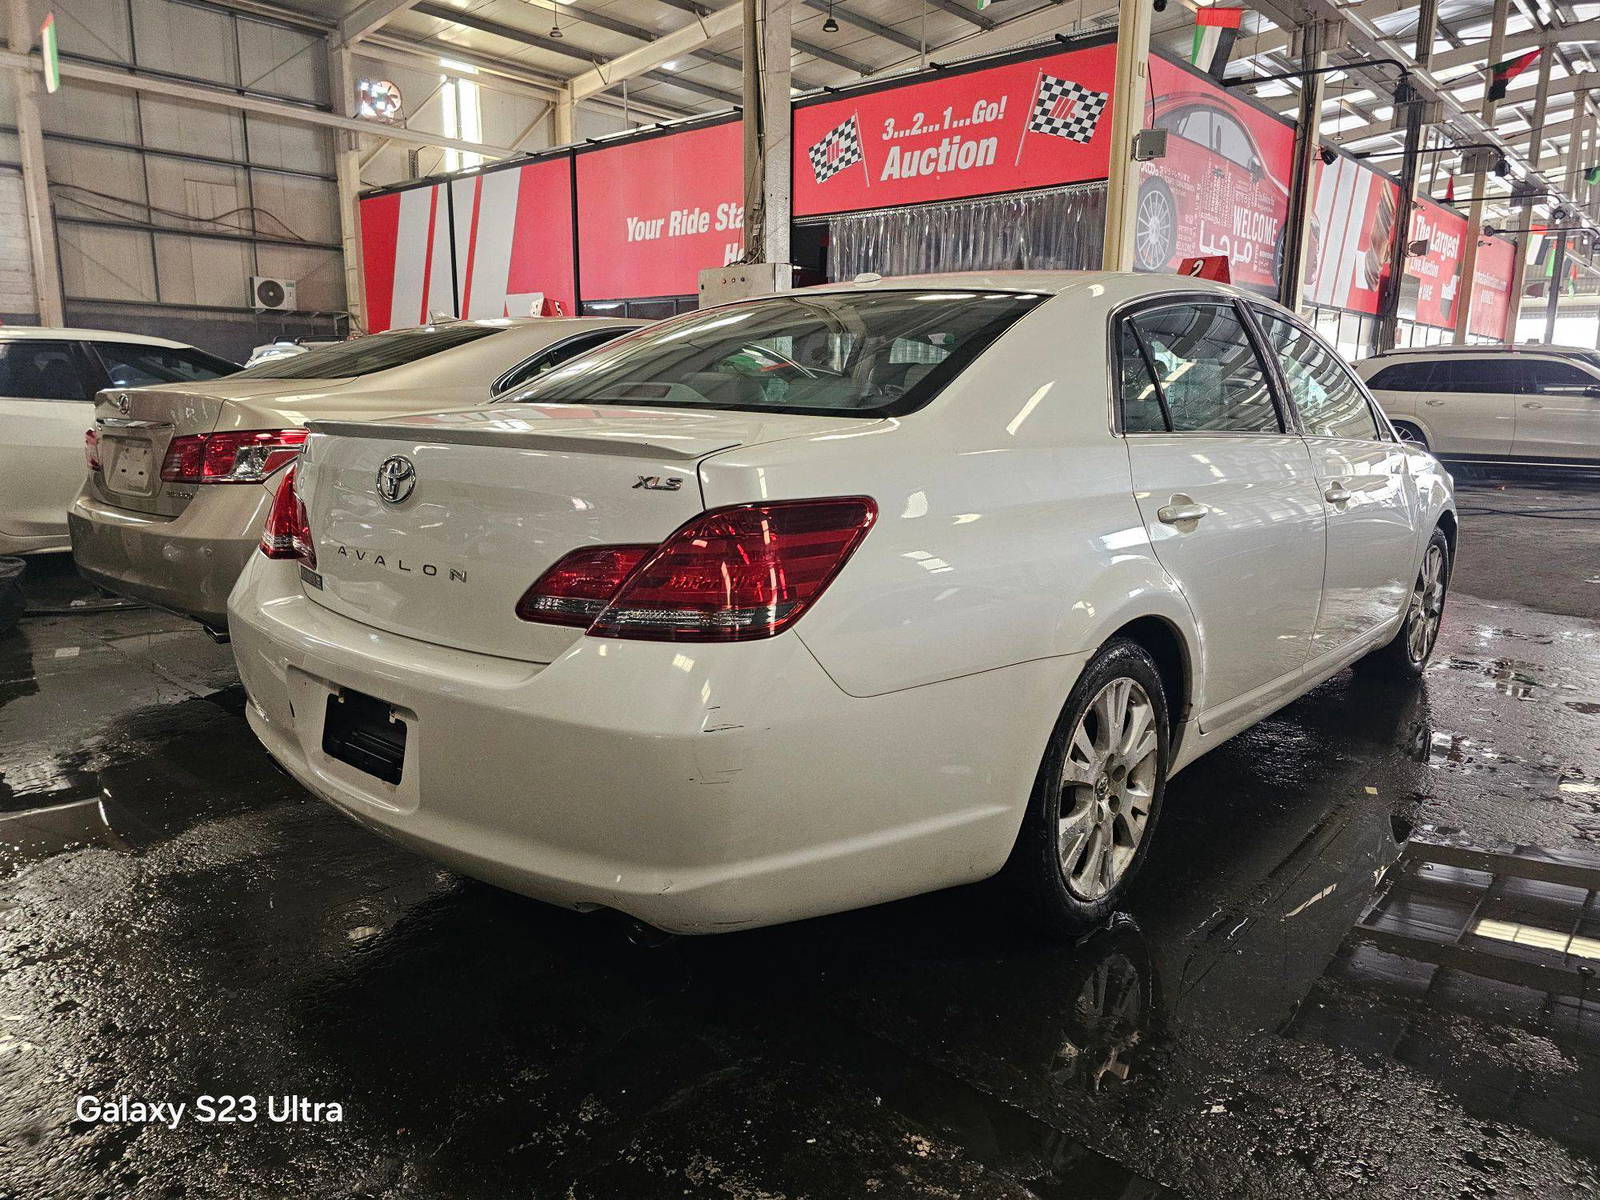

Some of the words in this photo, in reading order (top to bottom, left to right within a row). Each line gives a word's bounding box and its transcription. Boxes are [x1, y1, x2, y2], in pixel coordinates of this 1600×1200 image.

[880, 136, 998, 181] Auction
[627, 215, 665, 242] Your
[668, 207, 710, 237] Ride
[715, 202, 745, 231] Sta
[1199, 219, 1253, 267] مرحبا
[1233, 205, 1278, 247] WELCOME
[1415, 215, 1431, 241] The
[1430, 223, 1460, 261] Largest
[632, 476, 683, 491] XLS
[338, 546, 467, 583] AVALON
